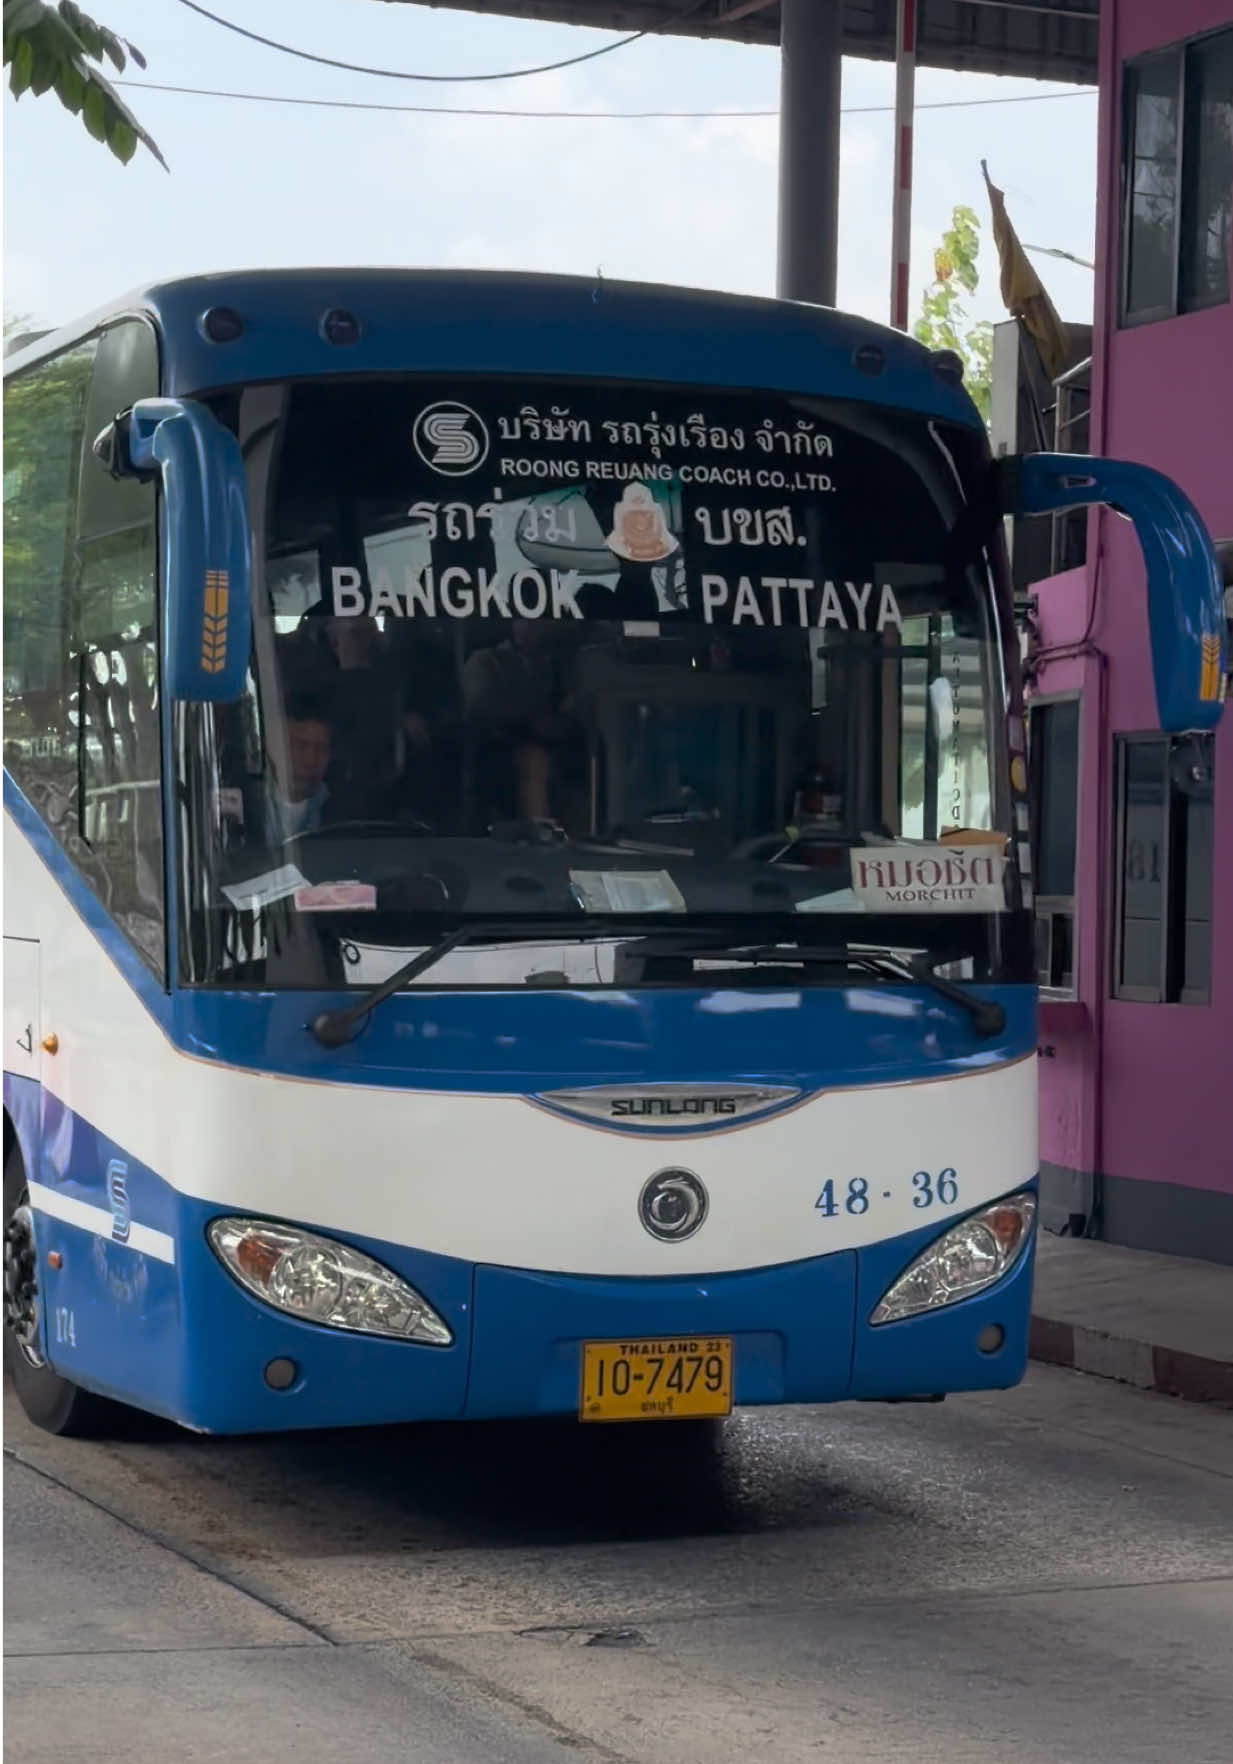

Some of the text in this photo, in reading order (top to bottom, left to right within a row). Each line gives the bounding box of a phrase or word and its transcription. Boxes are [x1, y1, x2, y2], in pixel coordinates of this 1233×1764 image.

[498, 405, 834, 460] บริษัท รถรุ่งเรือง จำกัด
[501, 458, 837, 493] ROONG REUANG COACH CO.,LTD.
[695, 505, 808, 547] บขส.
[331, 565, 585, 620] BANGKOK
[701, 574, 903, 633] PATTAYA
[857, 848, 994, 889] หมอชิต
[885, 887, 976, 902] MORCHIT
[611, 1098, 736, 1117] SUNLONG
[814, 1176, 870, 1218] 48
[911, 1167, 959, 1209] 36
[55, 1306, 77, 1348] 174
[619, 1342, 699, 1356] THAILAND
[597, 1355, 724, 1397] 10-7479
